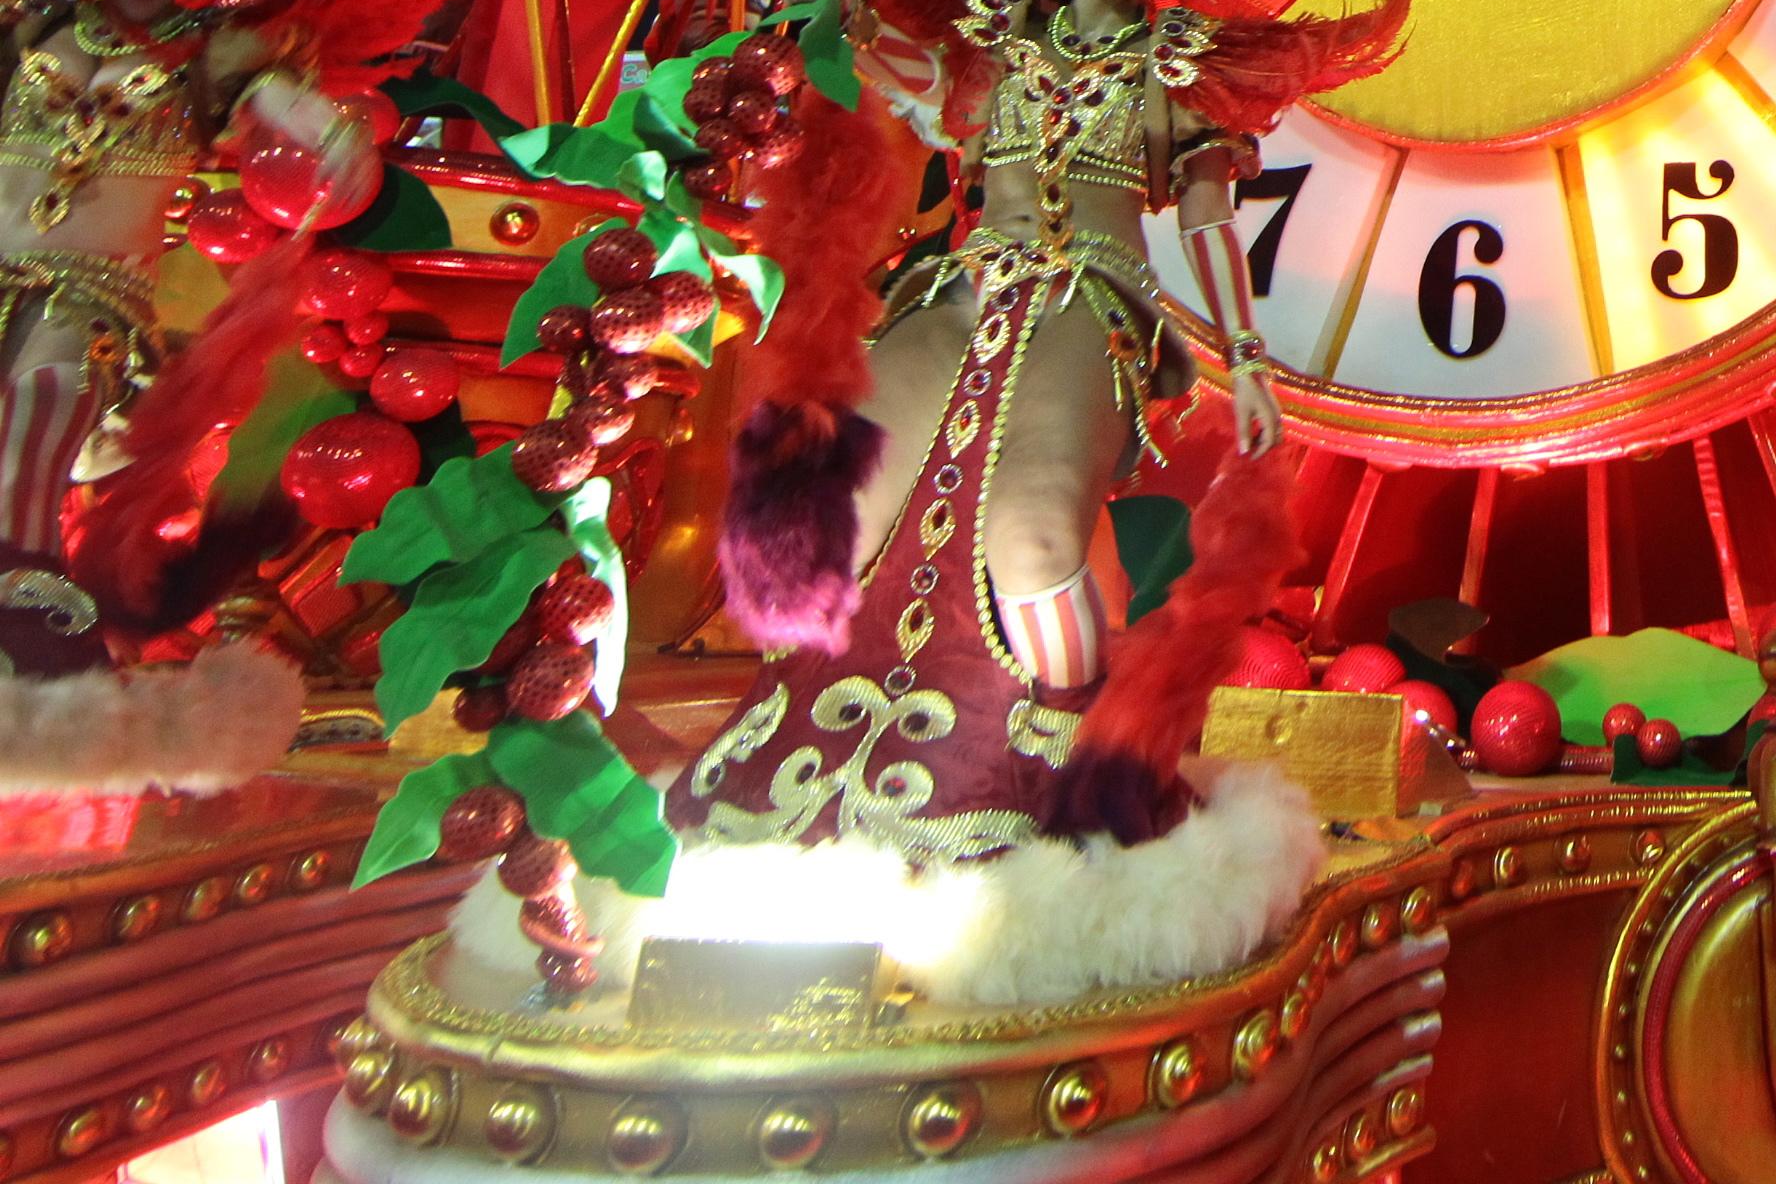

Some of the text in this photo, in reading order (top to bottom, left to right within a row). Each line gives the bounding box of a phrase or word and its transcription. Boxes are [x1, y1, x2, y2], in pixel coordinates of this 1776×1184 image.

[1233, 163, 1312, 297] 7
[1418, 220, 1506, 359] 6
[1650, 159, 1740, 299] 5
